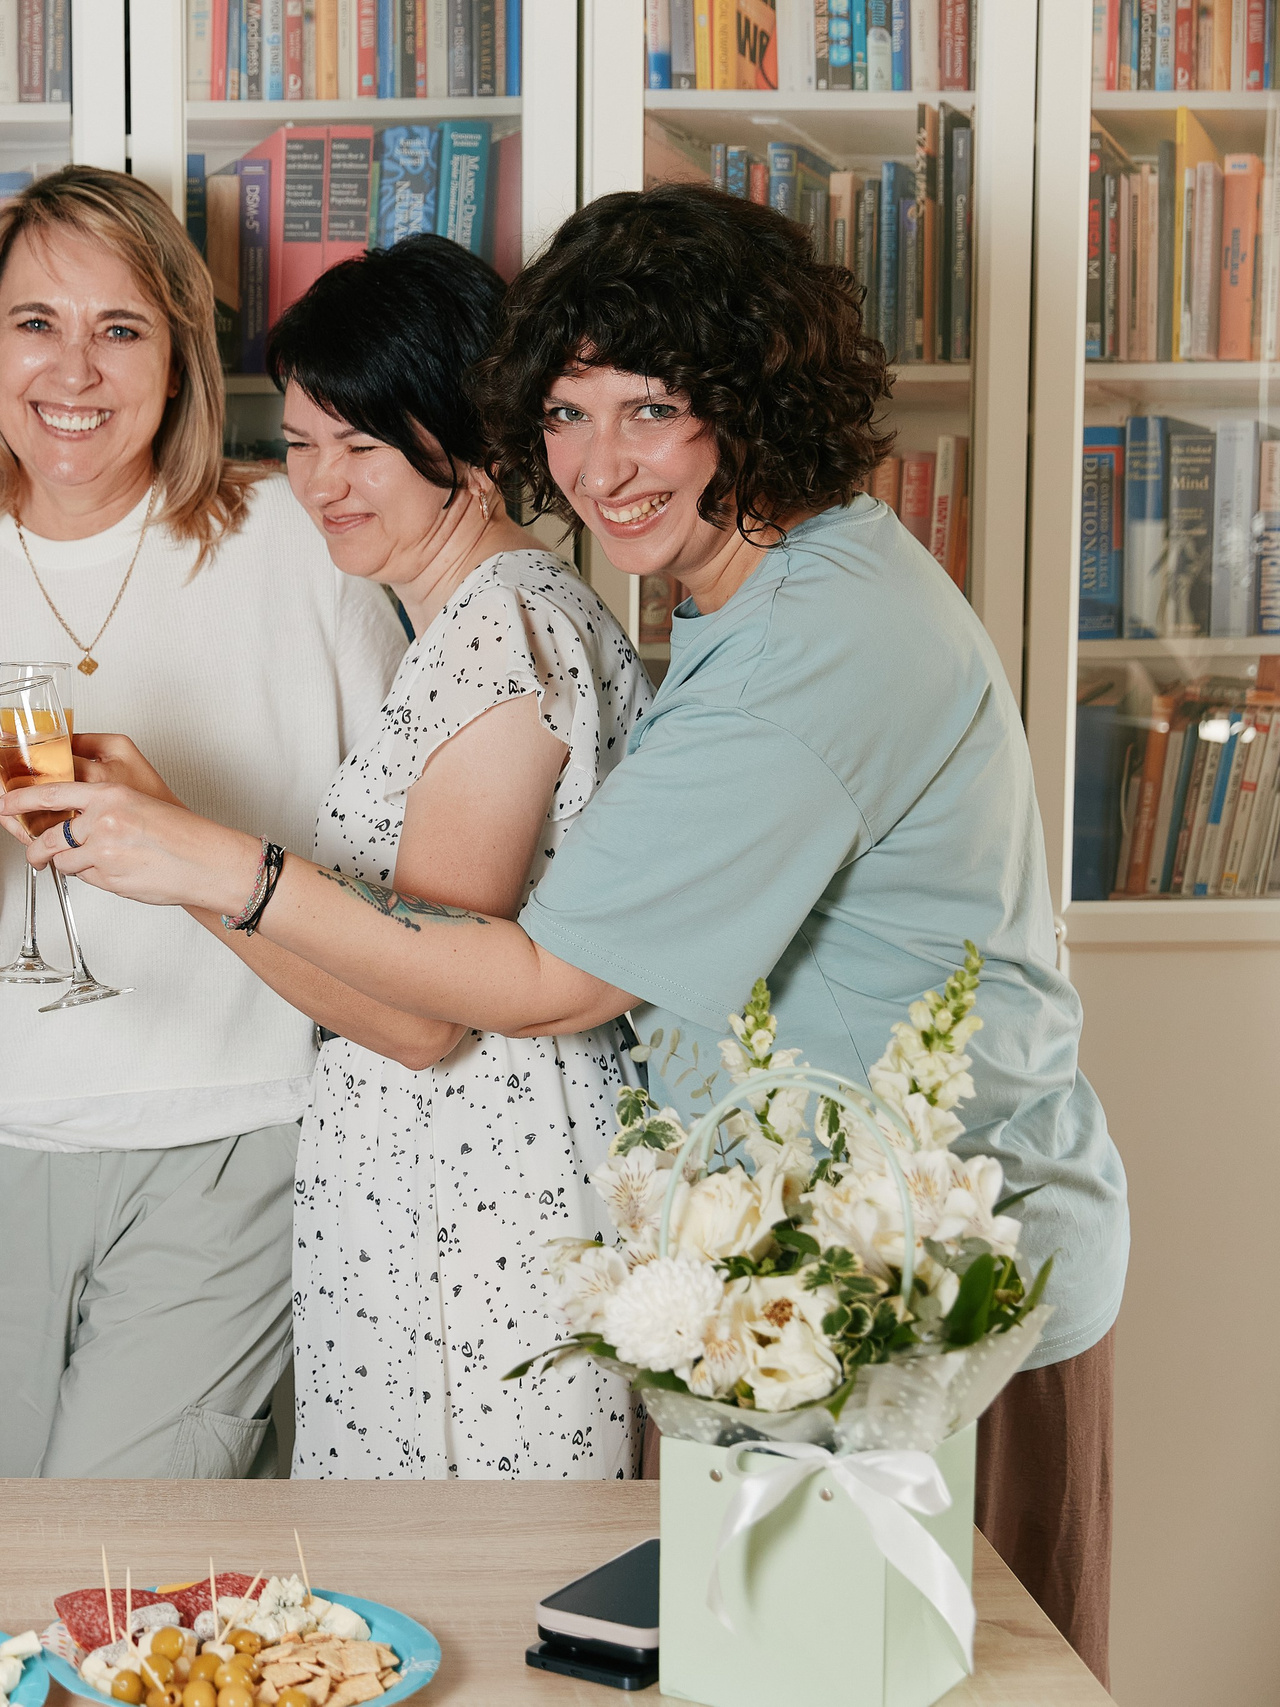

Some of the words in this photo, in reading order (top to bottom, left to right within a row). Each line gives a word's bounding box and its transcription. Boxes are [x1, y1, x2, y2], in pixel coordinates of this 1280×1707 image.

[247, 3, 262, 76] Madness
[453, 26, 466, 79] DISGUST
[1089, 198, 1101, 259] LEICA
[1088, 260, 1100, 279] M
[1172, 475, 1209, 491] Mind
[1081, 457, 1099, 592] DICTIONARY
